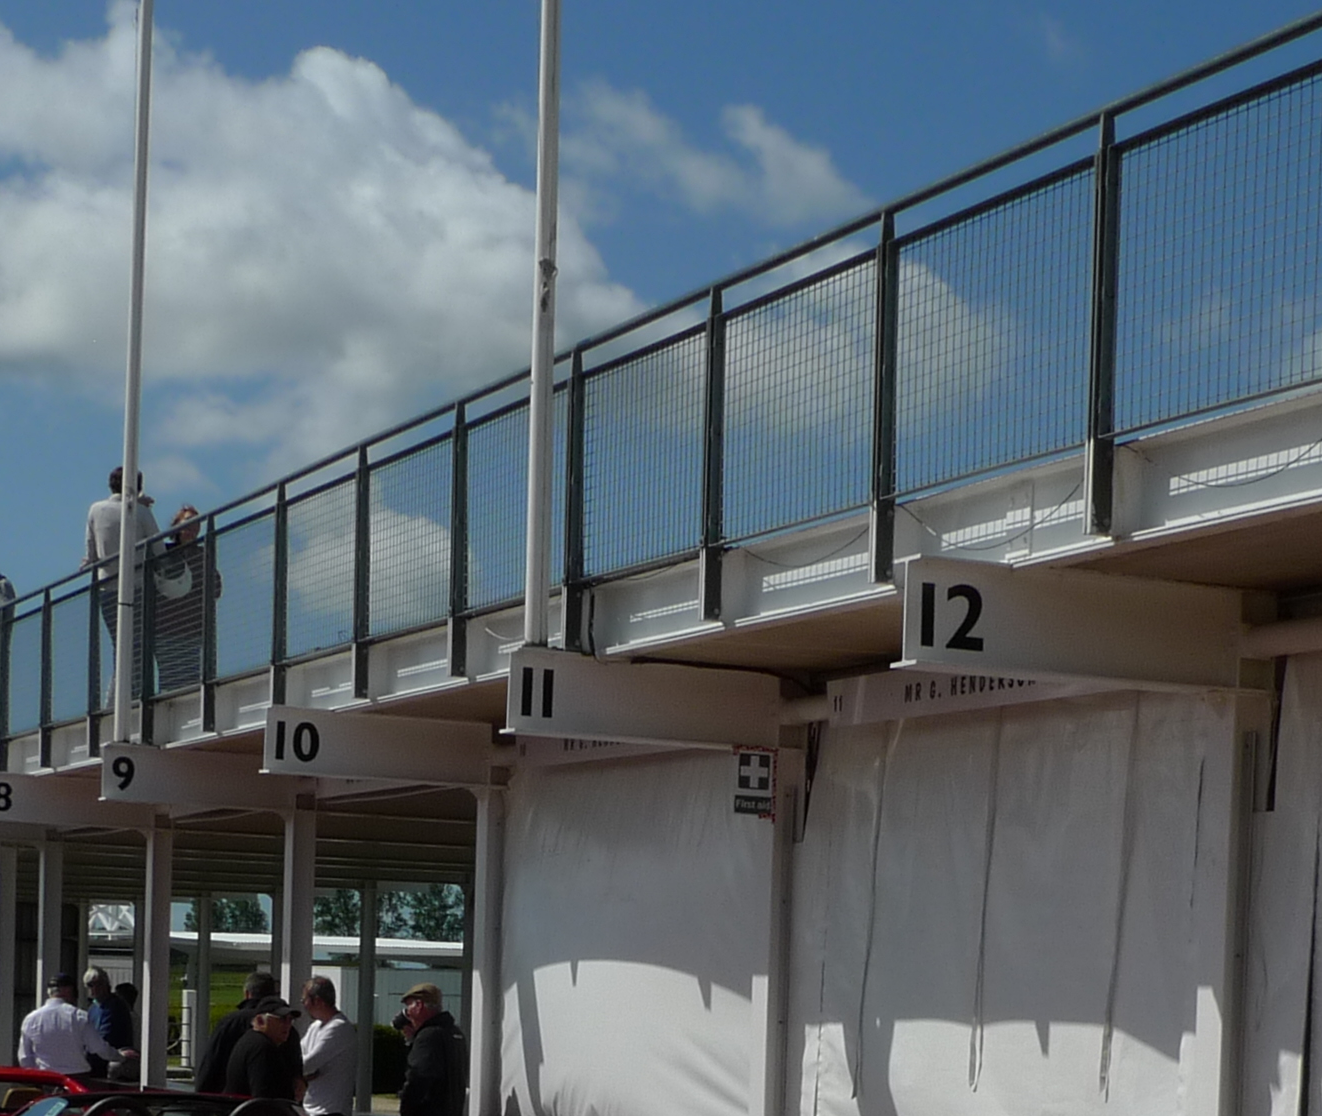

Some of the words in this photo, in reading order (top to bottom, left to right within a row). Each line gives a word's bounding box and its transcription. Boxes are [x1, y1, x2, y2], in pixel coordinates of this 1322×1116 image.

[920, 582, 984, 652] 12
[522, 667, 554, 718] 11
[904, 682, 922, 703] MR
[929, 680, 942, 699] G.
[275, 720, 320, 762] 10
[112, 756, 135, 790] 9
[735, 798, 756, 809] First
